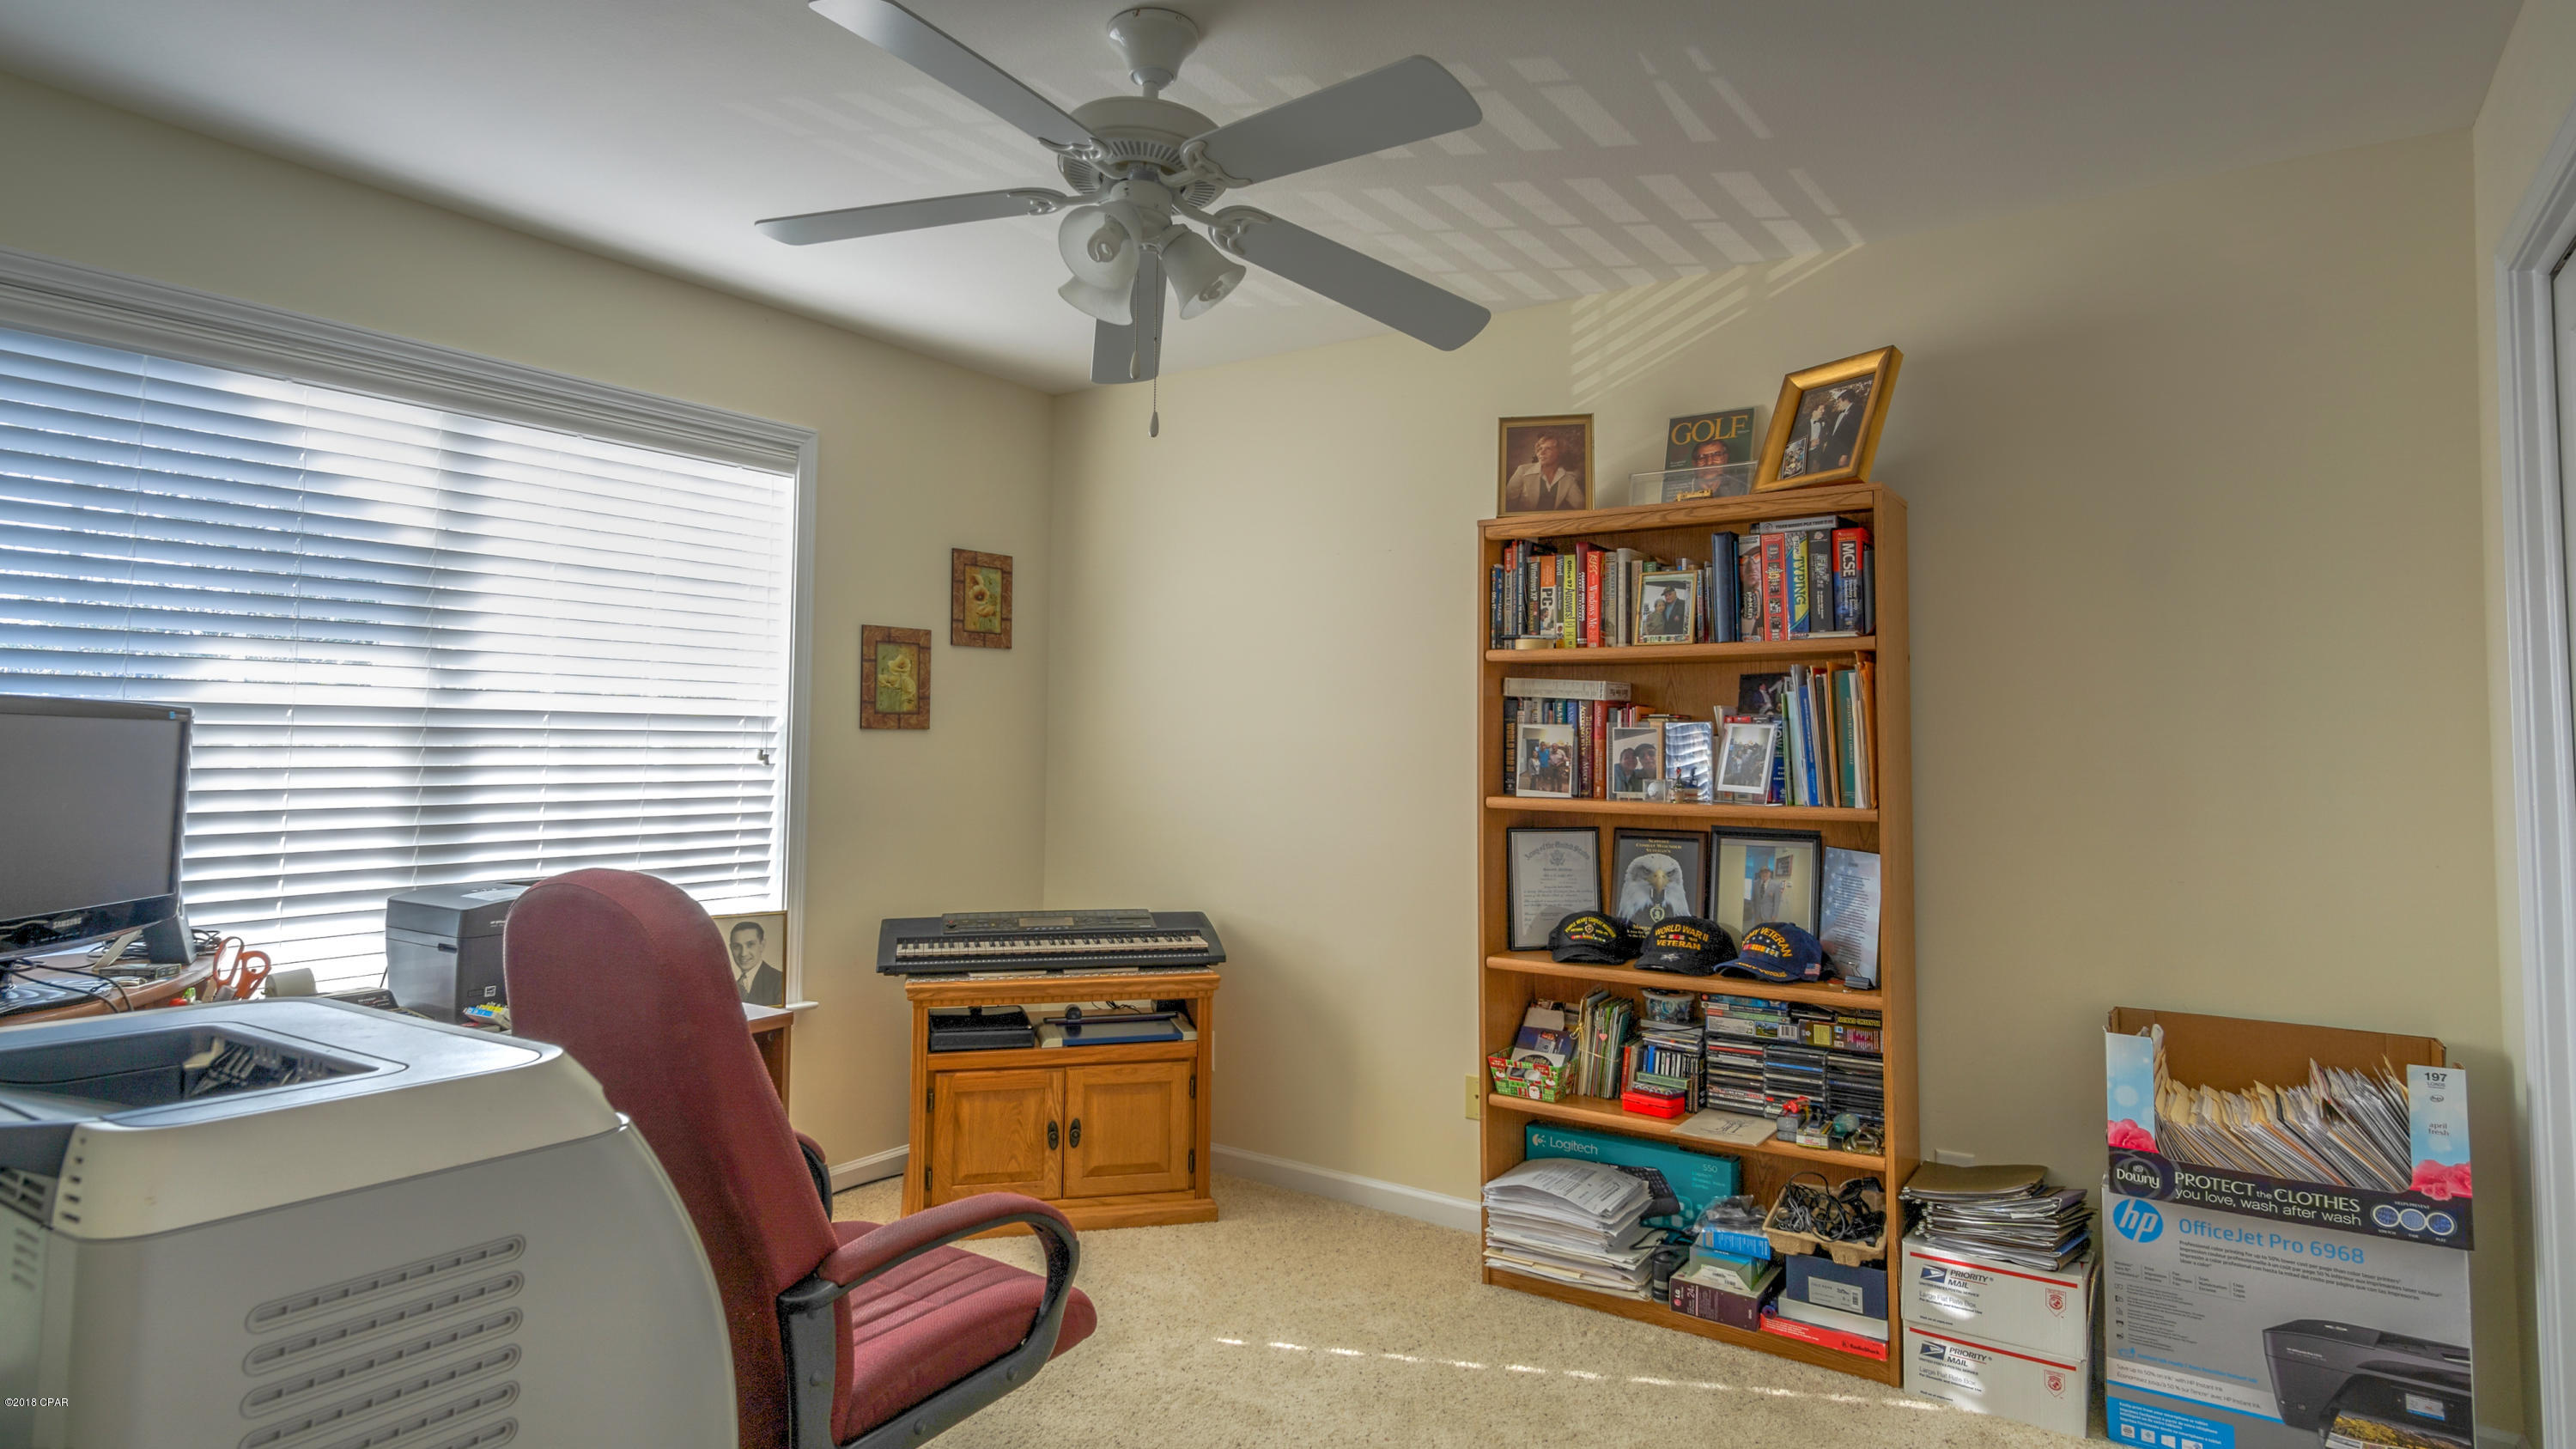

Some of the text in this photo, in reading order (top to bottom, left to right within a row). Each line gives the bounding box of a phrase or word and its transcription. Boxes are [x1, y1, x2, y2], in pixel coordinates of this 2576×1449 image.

[1672, 415, 1748, 445] GOLF
[1842, 543, 1855, 577] MCSE
[1794, 556, 1807, 605] TYPING
[1542, 588, 1552, 606] PC
[1565, 588, 1575, 619] Answers!
[1589, 618, 1597, 628] Me
[1506, 723, 1515, 747] WORLD
[1506, 749, 1515, 765] WAR
[53, 917, 82, 929] SAMSUNG
[1655, 924, 1681, 936] WORLD
[1682, 926, 1703, 941] WAR
[1703, 933, 1710, 941] II
[1656, 940, 1701, 950] VETERAN
[1760, 927, 1793, 957] VETERAN
[2425, 1072, 2447, 1081] 197
[1550, 1136, 1598, 1155] Logitech
[2117, 1167, 2160, 1190] Downy
[2174, 1172, 2361, 1213] PROTECT the CLOTHES
[2175, 1188, 2361, 1227] you love, wash after wash
[2119, 1200, 2158, 1243] hp
[2178, 1218, 2365, 1264] OfficeJet Pro 6968
[1947, 1279, 1969, 1288] MAIL
[1950, 1269, 1988, 1282] PRIORITY
[1674, 1289, 1680, 1298] LG
[1919, 1291, 1936, 1300] Large
[1937, 1294, 1948, 1302] Flat
[1949, 1296, 1963, 1305] Rate
[1850, 1343, 1880, 1355] RadioShack
[1949, 1348, 1987, 1361] PRIORITY
[1947, 1356, 1968, 1367] MAIL
[1919, 1366, 1936, 1377] Large
